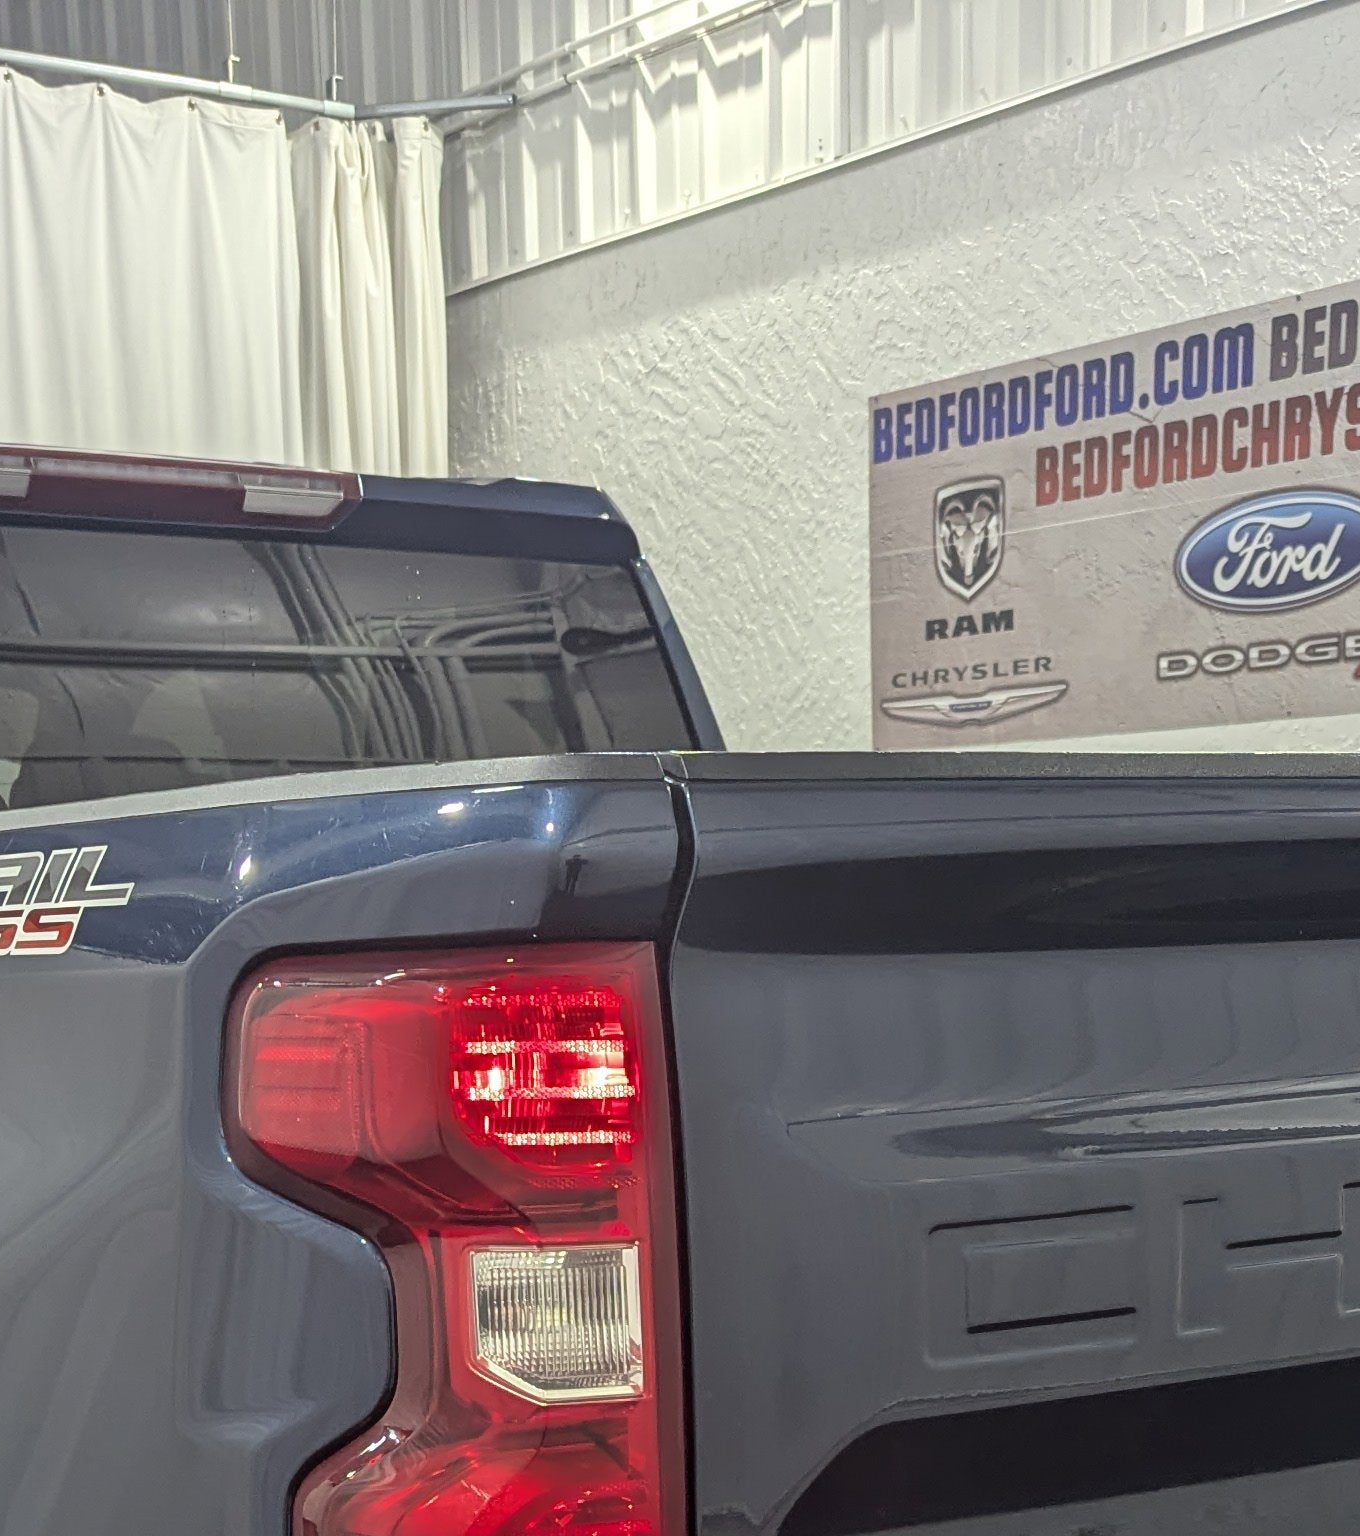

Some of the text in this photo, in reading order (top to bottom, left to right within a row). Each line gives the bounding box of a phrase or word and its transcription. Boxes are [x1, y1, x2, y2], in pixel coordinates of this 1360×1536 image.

[873, 322, 1255, 464] BEDFORDFORD.COM
[1213, 511, 1345, 593] Ford
[925, 609, 1014, 641] RAM
[892, 656, 1052, 688] CHRYSLER
